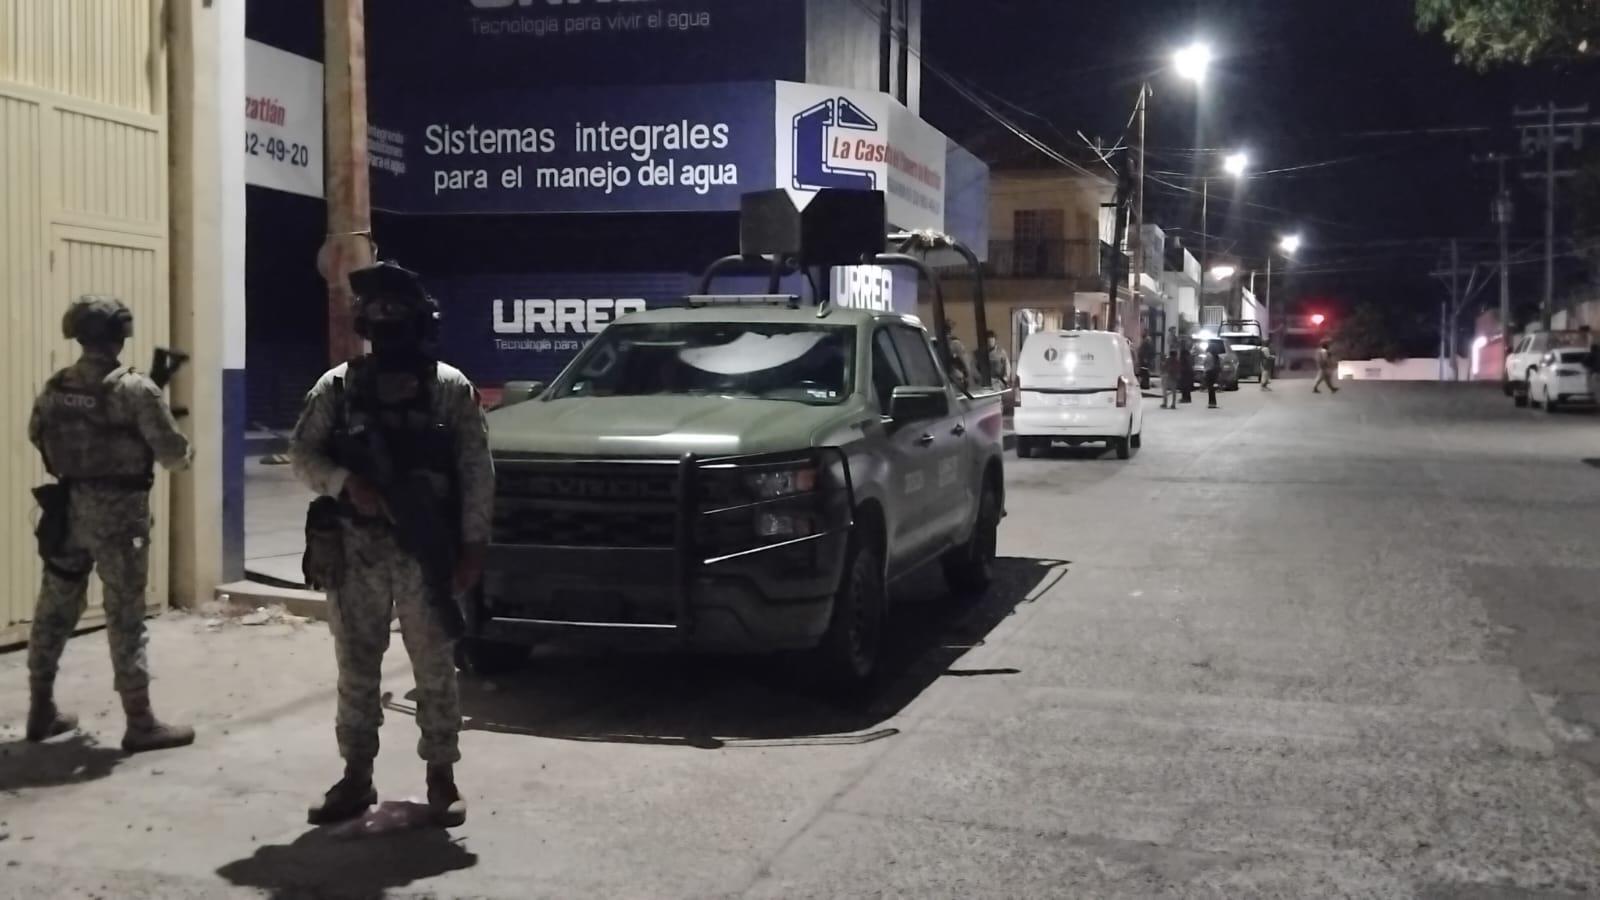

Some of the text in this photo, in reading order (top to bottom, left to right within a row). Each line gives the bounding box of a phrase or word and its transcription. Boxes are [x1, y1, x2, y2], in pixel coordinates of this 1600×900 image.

[564, 16, 600, 34] para
[607, 12, 641, 30] vivir
[648, 9, 662, 28] el
[668, 12, 710, 30] agua
[424, 123, 556, 155] Sistemas
[575, 119, 729, 162] integrales
[832, 136, 851, 159] La
[434, 158, 737, 195] para el manejo del agua
[836, 265, 893, 312] URREA
[554, 340, 578, 352] para
